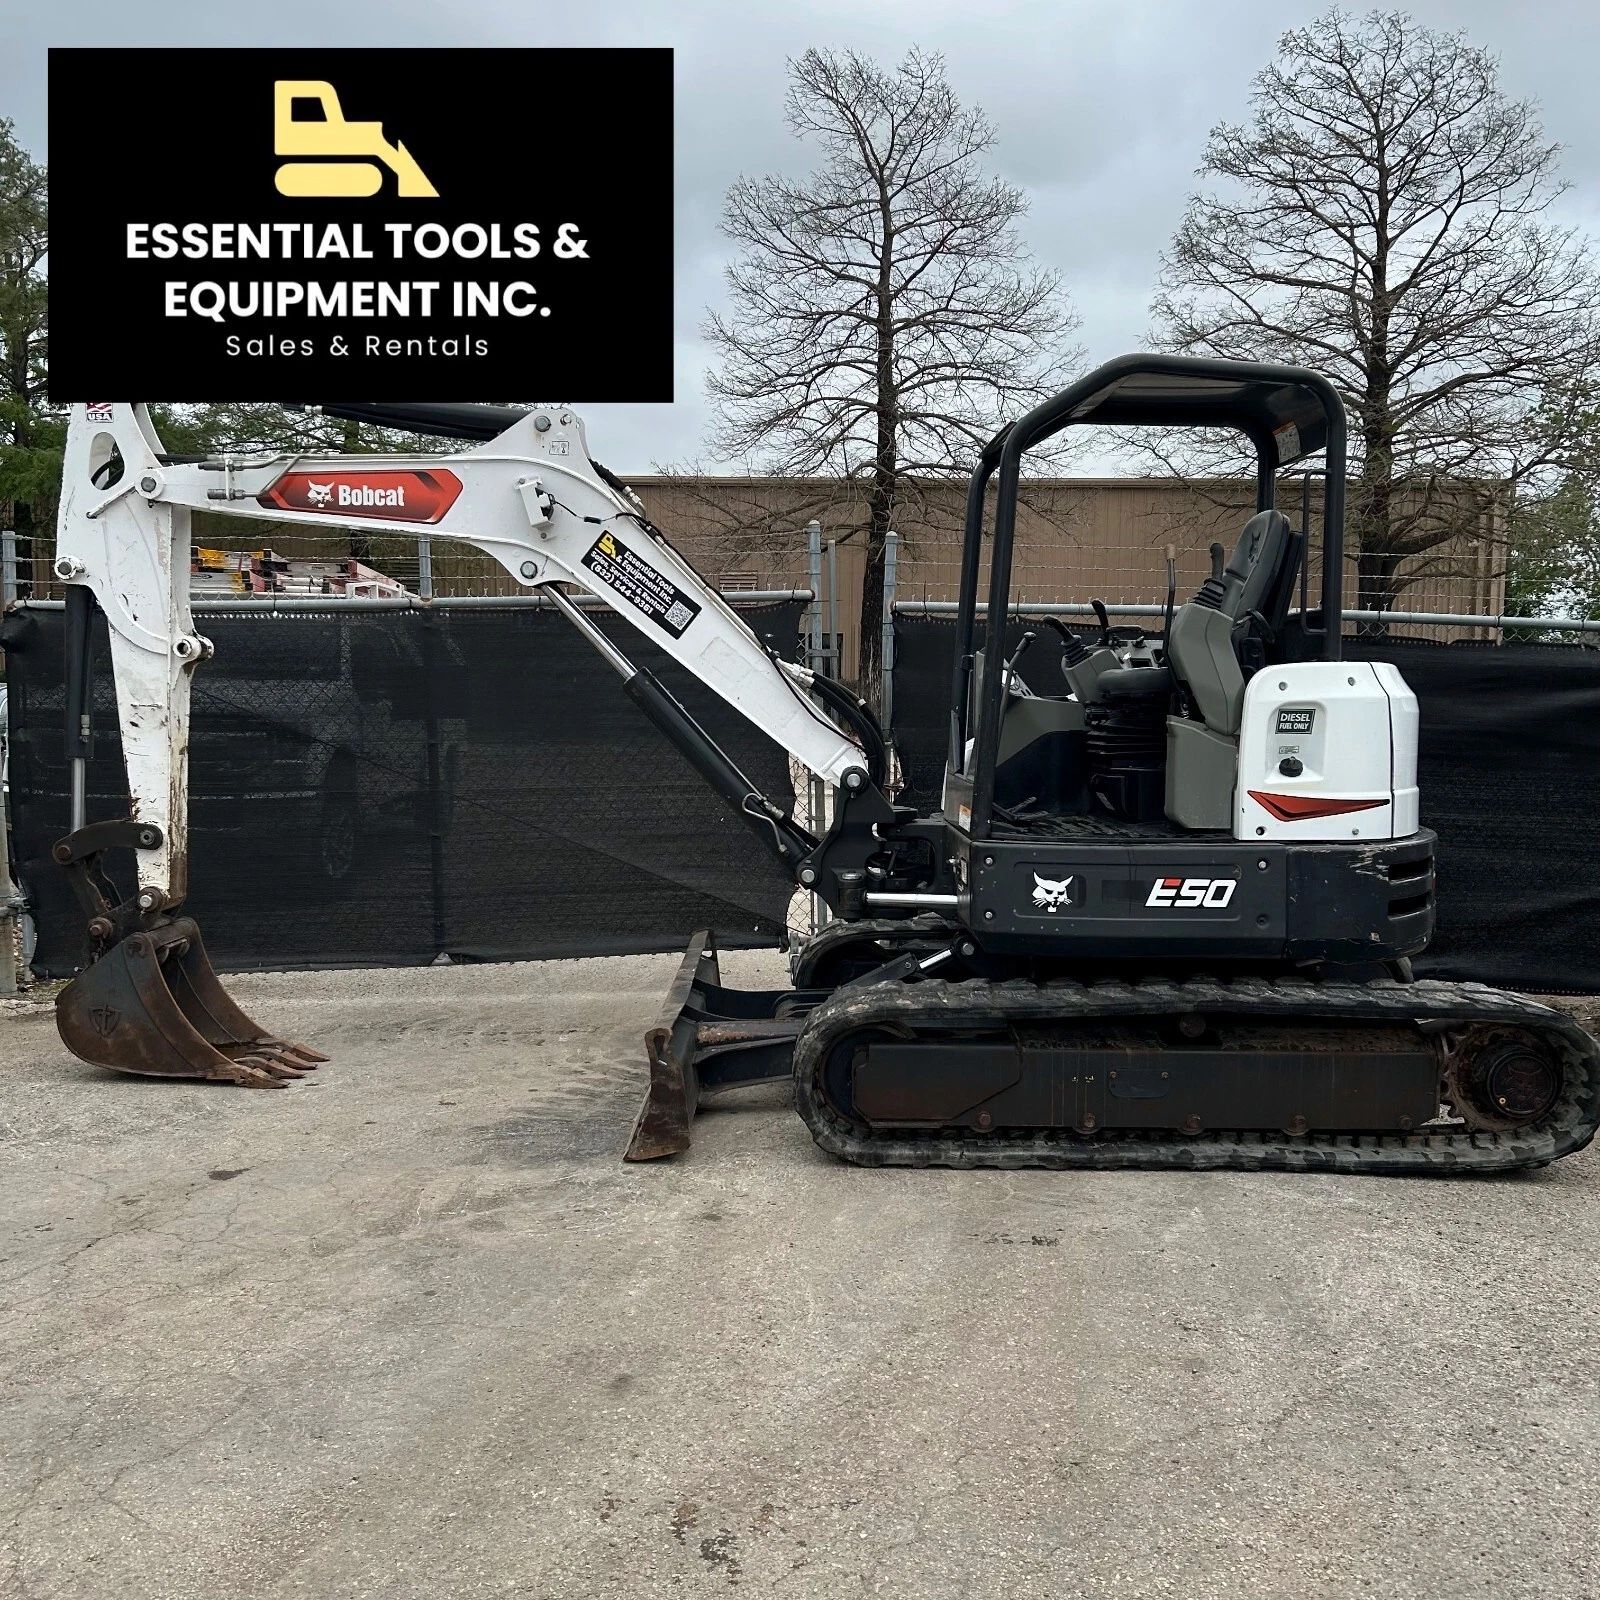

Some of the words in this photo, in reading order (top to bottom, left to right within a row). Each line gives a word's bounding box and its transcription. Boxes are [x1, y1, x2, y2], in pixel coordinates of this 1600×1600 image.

[338, 485, 405, 507] Bobcat
[590, 551, 609, 569] Sales,
[609, 564, 637, 590] Services
[635, 586, 642, 594] &
[641, 592, 666, 613] Rentals
[590, 561, 615, 583] (832)
[614, 580, 654, 614] 544-9361
[615, 555, 623, 563] &
[622, 560, 661, 594] Equipment
[659, 592, 672, 605] Inc.
[624, 551, 656, 579] Essential
[656, 574, 675, 595] Tools
[1280, 713, 1310, 721] DIESEL
[1145, 878, 1237, 908] E50
